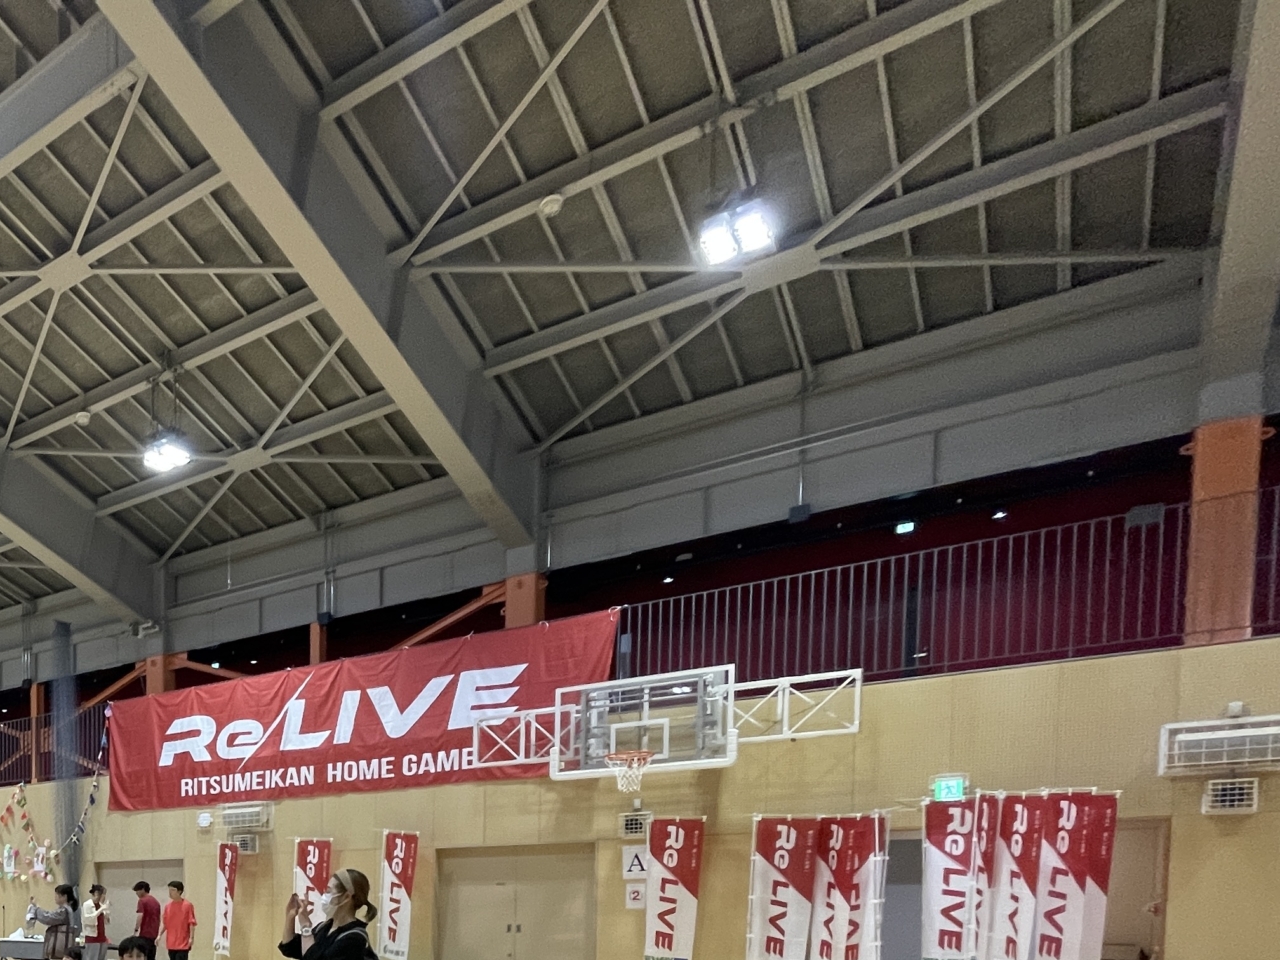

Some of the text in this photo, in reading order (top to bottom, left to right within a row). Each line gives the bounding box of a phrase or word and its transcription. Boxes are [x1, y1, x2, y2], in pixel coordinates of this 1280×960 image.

[180, 765, 314, 797] RITSUMEIKAN
[327, 757, 395, 783] HOME
[626, 853, 646, 872] A
